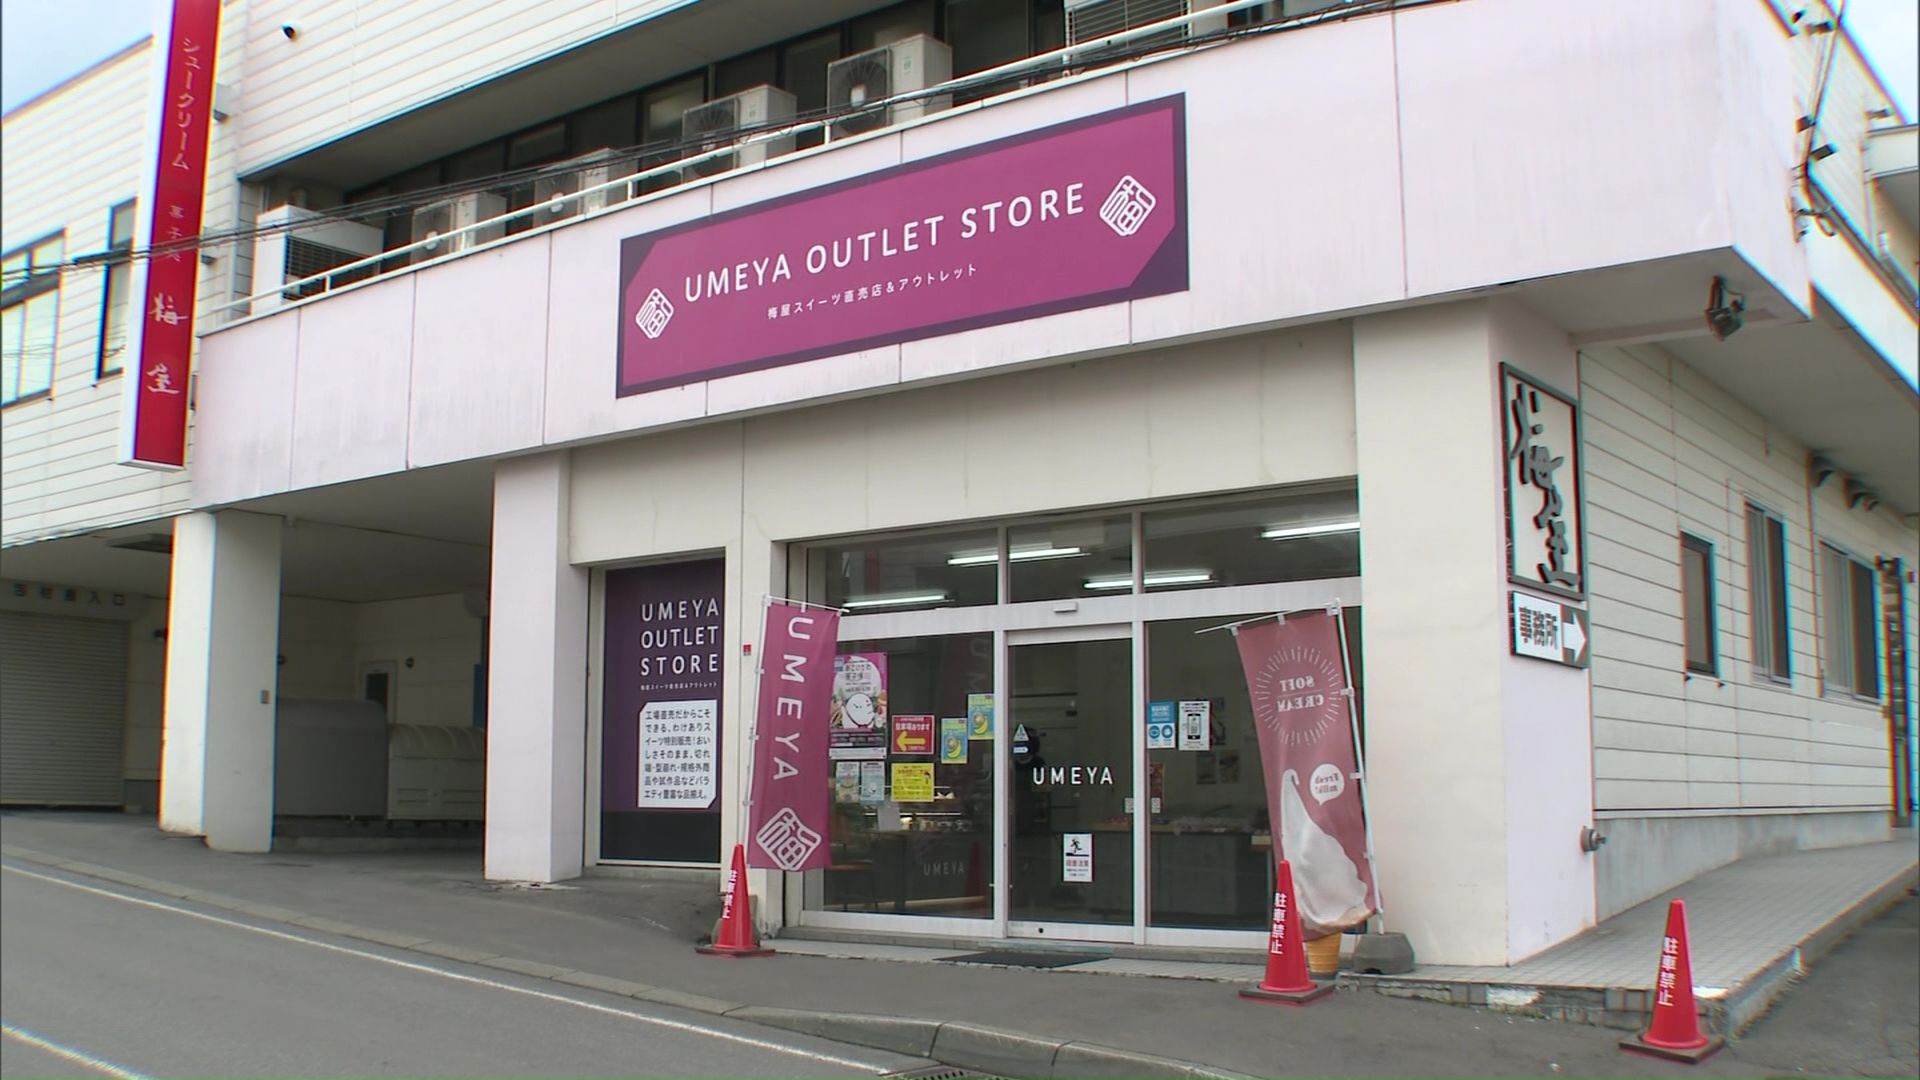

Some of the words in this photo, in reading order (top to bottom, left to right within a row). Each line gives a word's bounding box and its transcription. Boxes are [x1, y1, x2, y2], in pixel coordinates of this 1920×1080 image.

[172, 37, 201, 172] シュークリーム
[685, 253, 792, 304] UMEYA
[806, 214, 946, 275] OUTLET
[961, 182, 1086, 239] STORE
[767, 263, 976, 320] 梅屋スイーツ直売店&アウトレット
[641, 597, 720, 623] UMEYA
[641, 625, 719, 649] OUTLET
[1519, 606, 1557, 650] 事務所
[641, 653, 719, 676] STORE
[774, 615, 814, 780] UMEYA
[1033, 766, 1113, 785] UMEYA
[1270, 892, 1288, 955] 駐車禁止
[1657, 936, 1679, 1007] 駐車禁止
